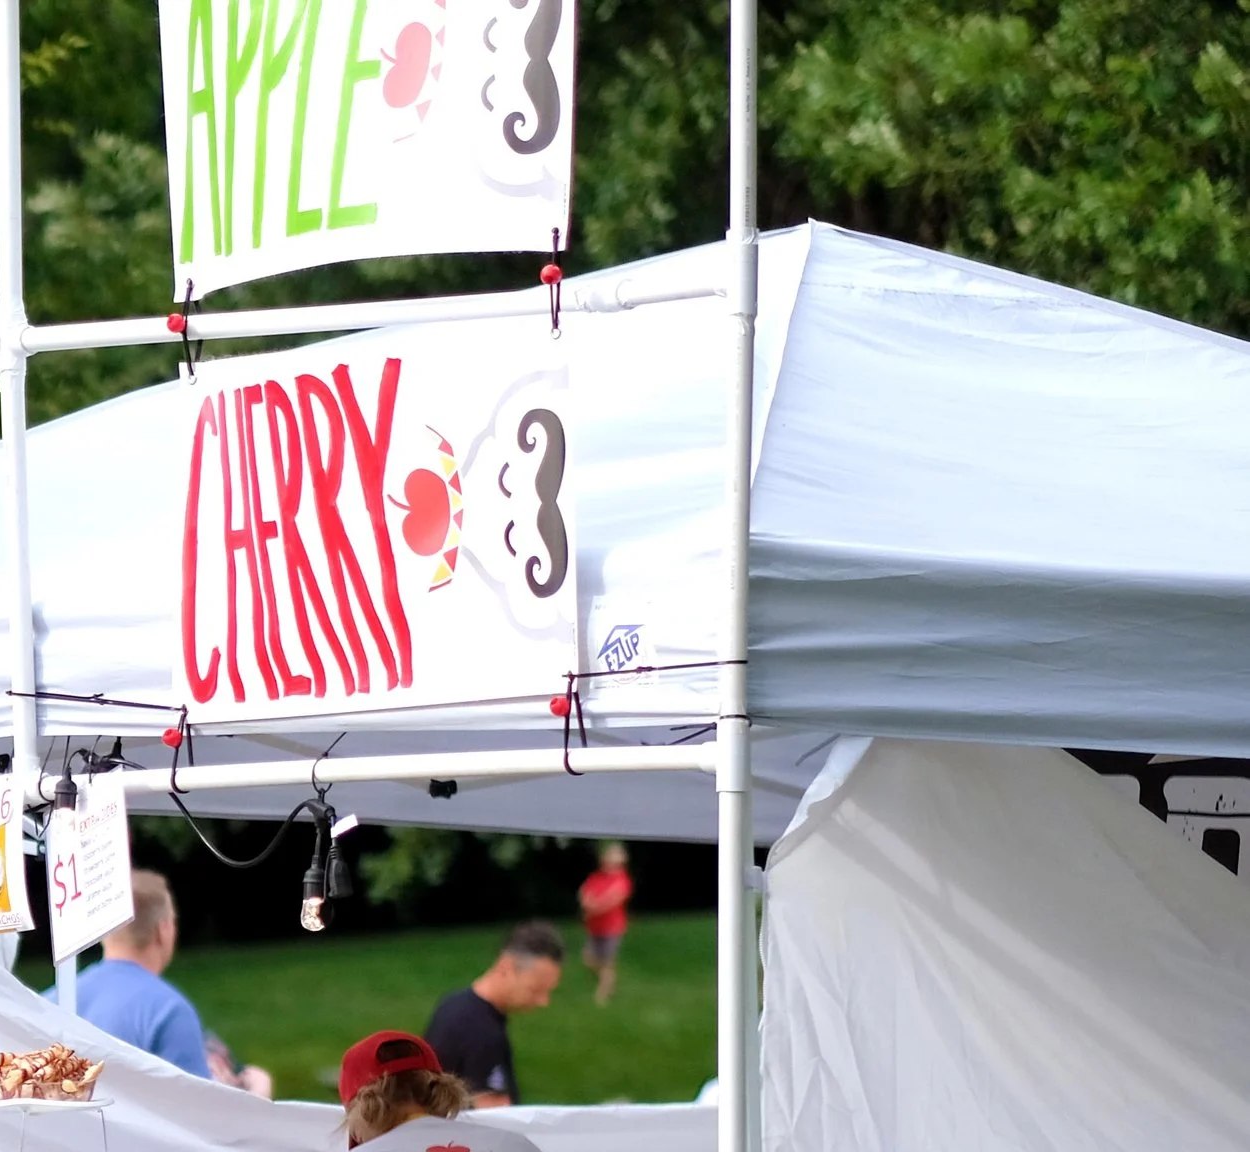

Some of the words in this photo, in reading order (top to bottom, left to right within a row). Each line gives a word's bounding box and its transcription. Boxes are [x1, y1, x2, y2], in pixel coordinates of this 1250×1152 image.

[180, 0, 380, 264] APPLE
[181, 357, 413, 703] CHERRY
[53, 853, 82, 918] $1
